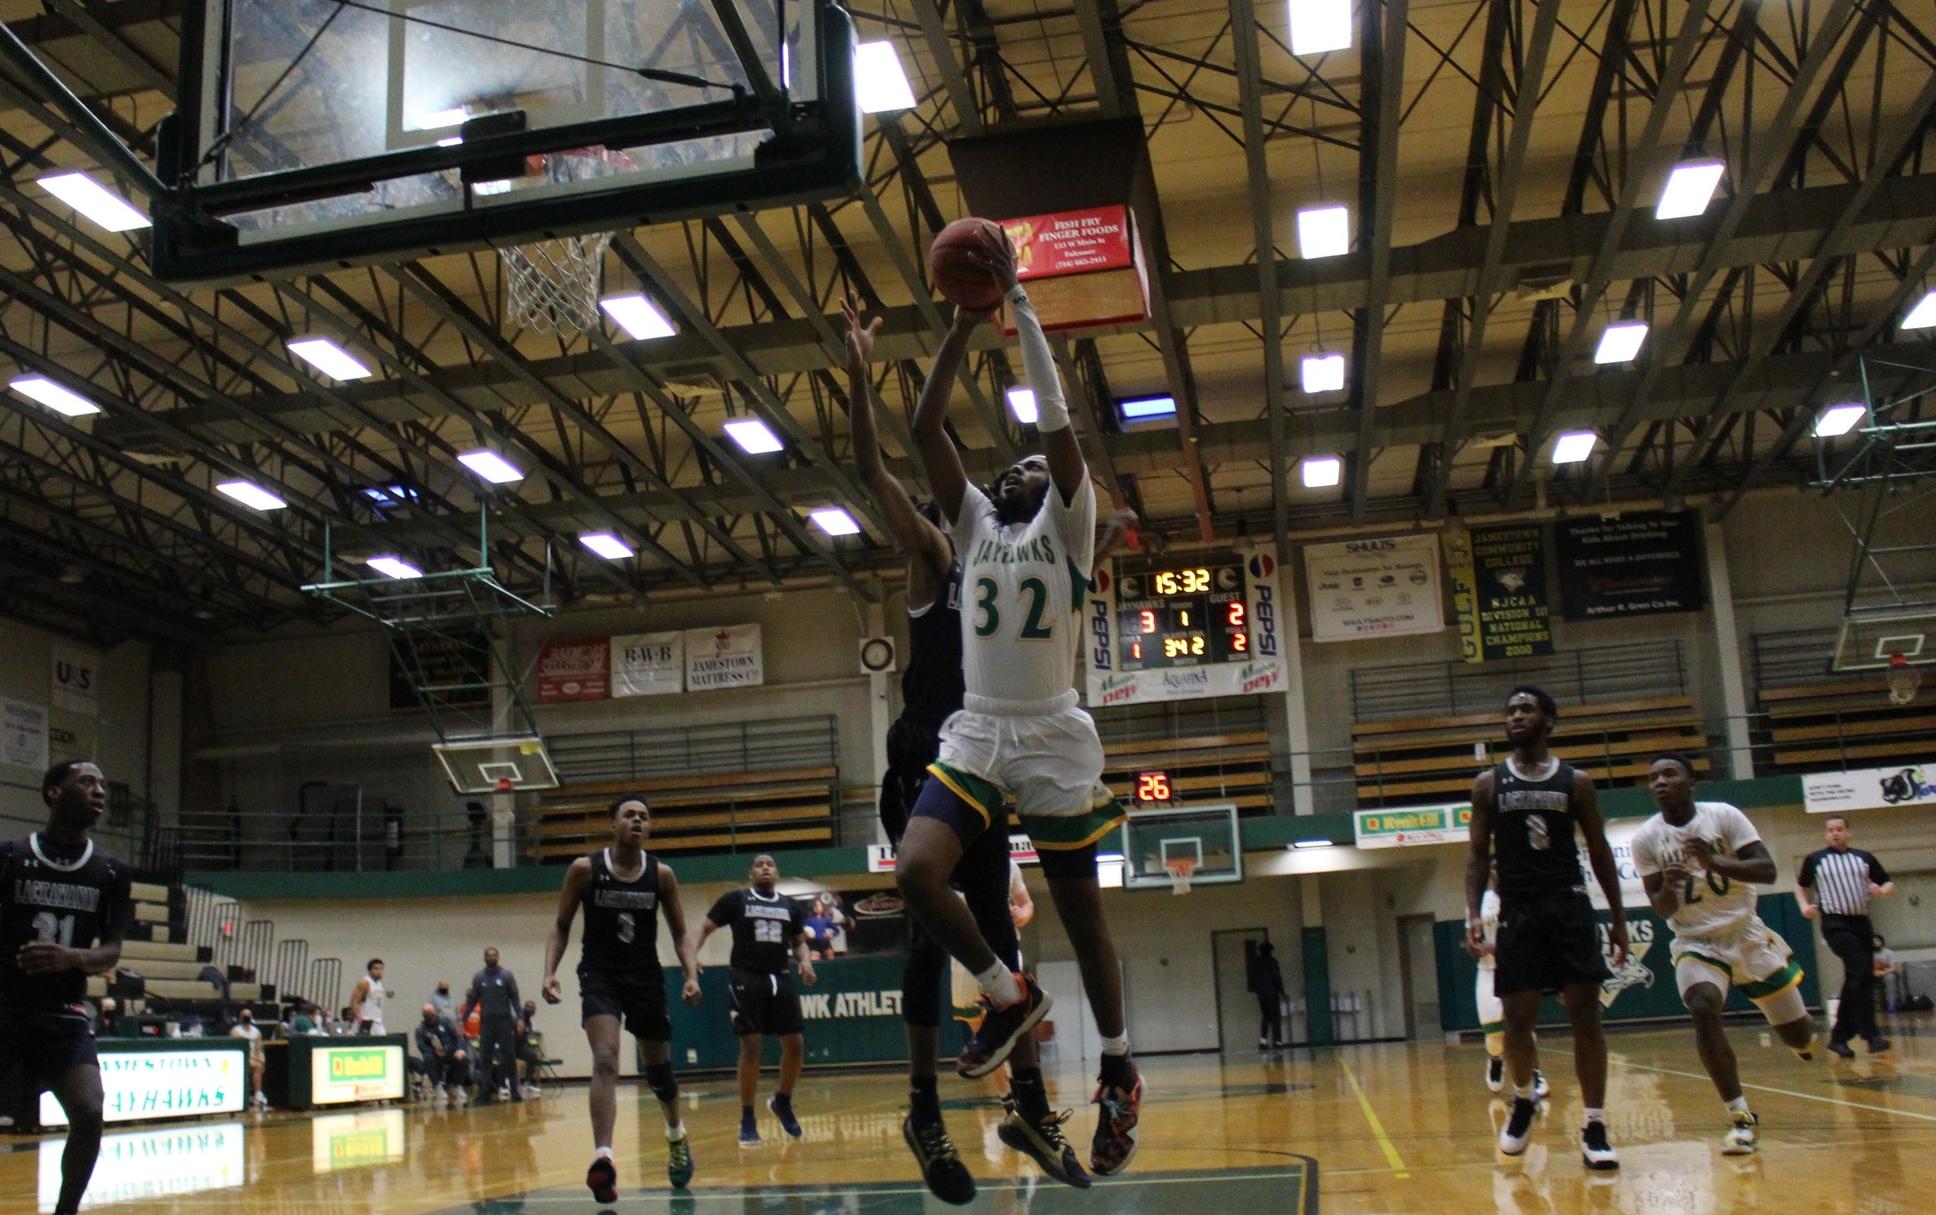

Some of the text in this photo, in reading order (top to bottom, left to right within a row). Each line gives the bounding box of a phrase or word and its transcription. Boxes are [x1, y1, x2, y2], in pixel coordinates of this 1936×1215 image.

[1054, 216, 1102, 230] FISH FRY
[1039, 229, 1081, 242] FINGER
[1082, 225, 1120, 237] FOODS
[1077, 238, 1097, 248] Main
[1476, 529, 1540, 541] JAMESTOWN
[1475, 541, 1540, 555] COMMUNITY
[1486, 555, 1534, 567] COLLEGE
[1155, 568, 1211, 595] 15:32
[1209, 592, 1242, 603] GUEST
[1491, 595, 1537, 609] NJCAA
[974, 577, 1053, 640] 32
[1481, 609, 1530, 622] DIVISION
[1586, 606, 1617, 614] Arthur
[1141, 603, 1243, 633] 3 1 2
[1254, 584, 1278, 657] PEPSI
[1490, 621, 1543, 633] NATIONAL
[1090, 600, 1112, 671] PEPSI
[1486, 631, 1552, 645] CHAMPIONS
[1134, 644, 1141, 659] 1
[1233, 633, 1246, 651] 2
[691, 655, 756, 674] JAMESTOWN
[691, 672, 744, 686] MATTRESS
[1139, 774, 1170, 801] 26
[754, 919, 784, 944] 22
[834, 990, 904, 1018] ATHLET
[102, 1086, 225, 1113] AYHAWKS
